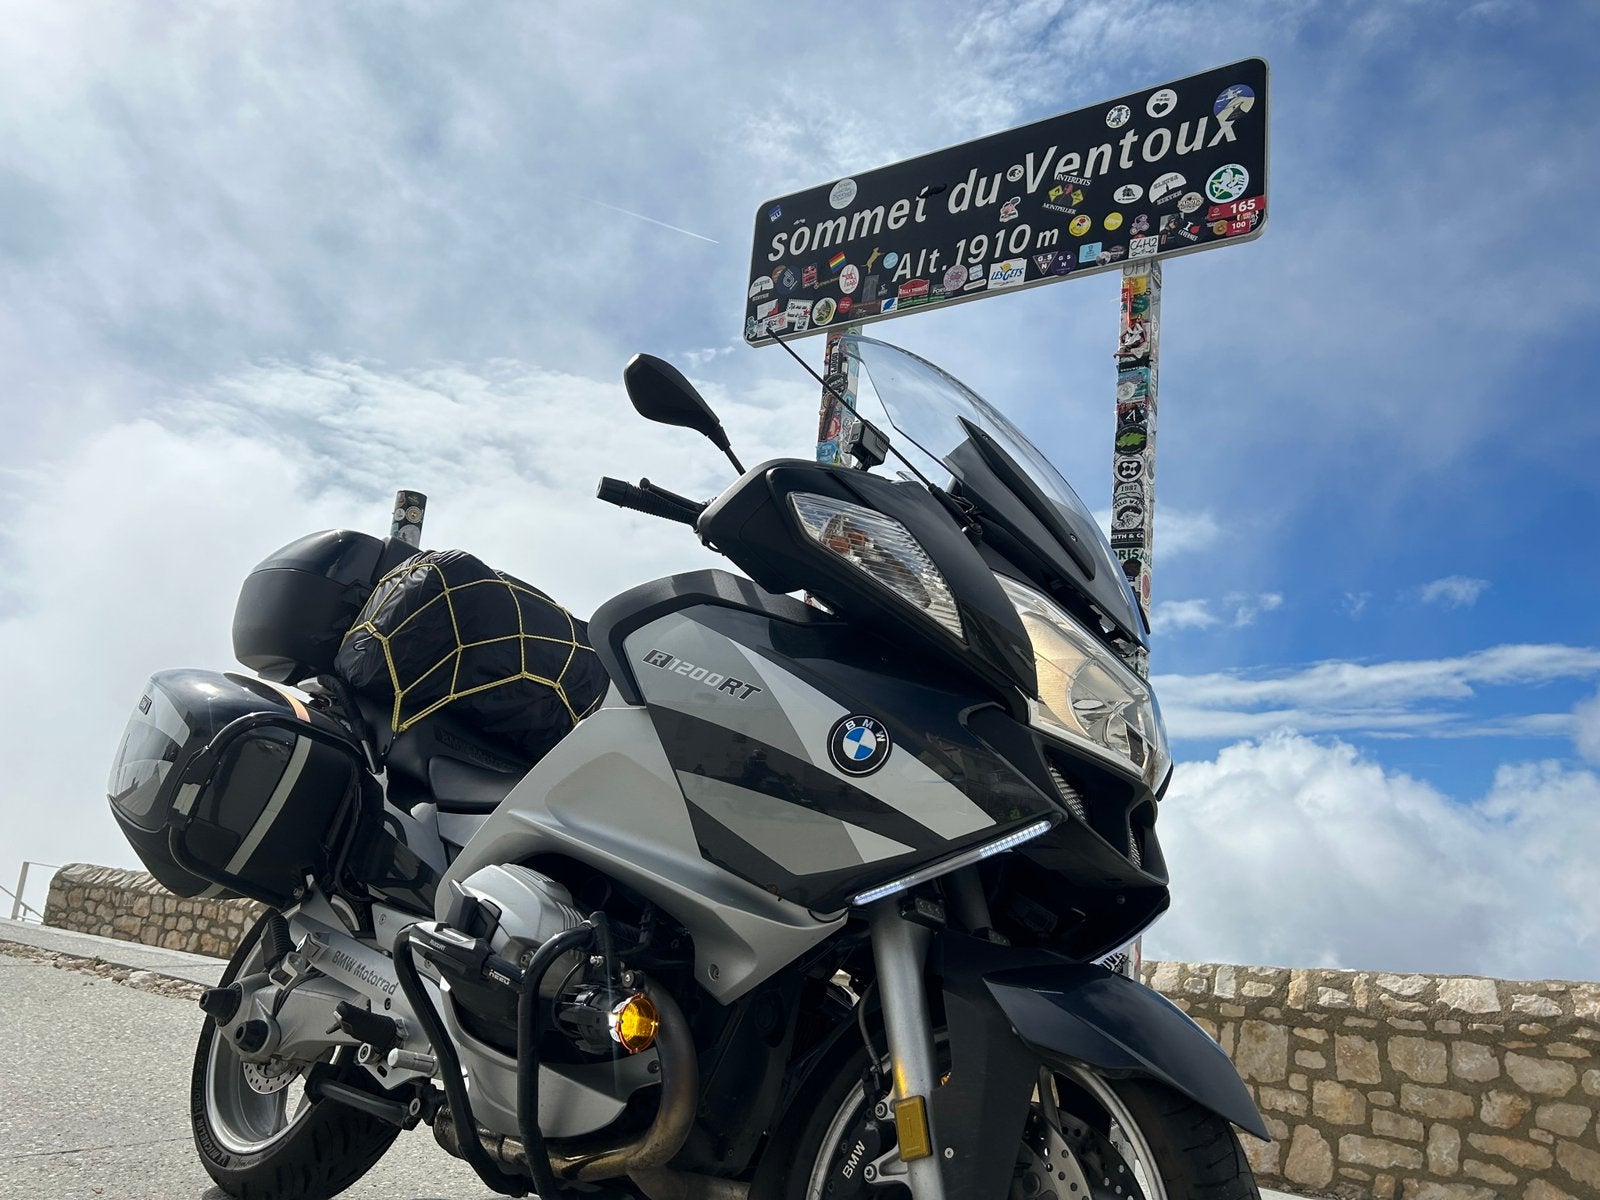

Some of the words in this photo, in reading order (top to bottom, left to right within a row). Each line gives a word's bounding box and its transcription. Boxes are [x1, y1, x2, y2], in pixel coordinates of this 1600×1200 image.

[948, 168, 1003, 214] du
[1025, 115, 1237, 194] Ventoux
[1056, 173, 1092, 187] INTERDITS
[1042, 202, 1077, 215] MONTPELLIER
[1230, 199, 1256, 214] 165
[1232, 221, 1246, 230] 100
[891, 248, 947, 283] Alt.
[955, 223, 1032, 267] 1910
[1036, 228, 1059, 249] m
[845, 719, 886, 742] BMW
[332, 950, 357, 972] BMW
[353, 962, 399, 995] Motorrad
[195, 1117, 220, 1161] MICHELIN
[843, 1140, 866, 1179] BMW
